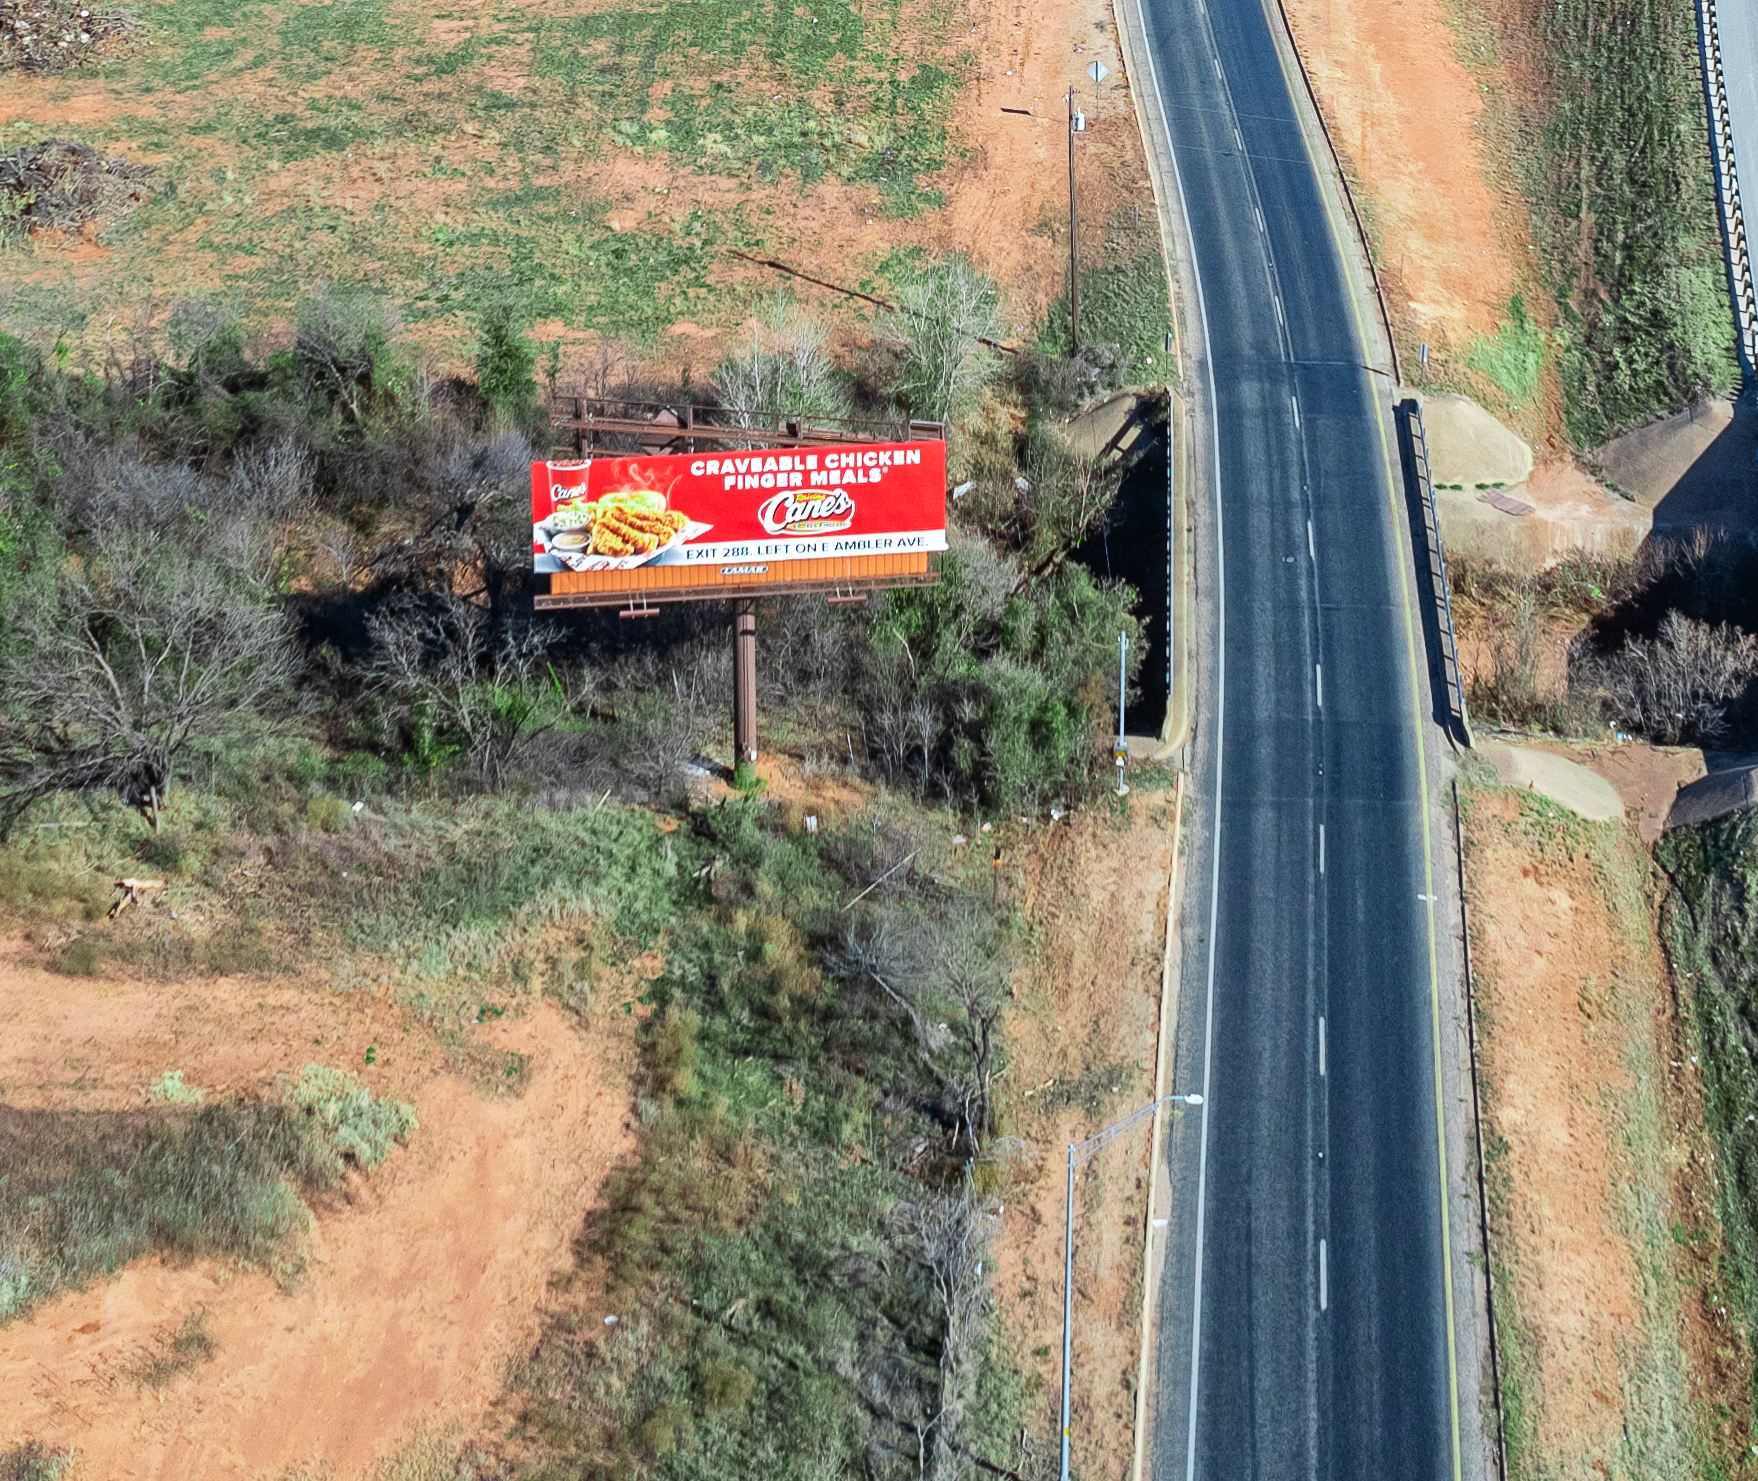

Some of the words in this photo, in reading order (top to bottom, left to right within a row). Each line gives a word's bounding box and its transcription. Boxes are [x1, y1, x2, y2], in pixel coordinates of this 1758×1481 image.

[690, 454, 819, 476] CRAVEABLE
[824, 449, 922, 469] CHICKEN
[724, 472, 803, 491] FINGER
[763, 490, 854, 531] Cane's
[686, 547, 718, 560] EXIT
[757, 543, 790, 556] LEFT
[795, 542, 818, 554] ON
[822, 541, 830, 552] E
[834, 538, 893, 552] AMBLER
[898, 536, 930, 548] AVE.
